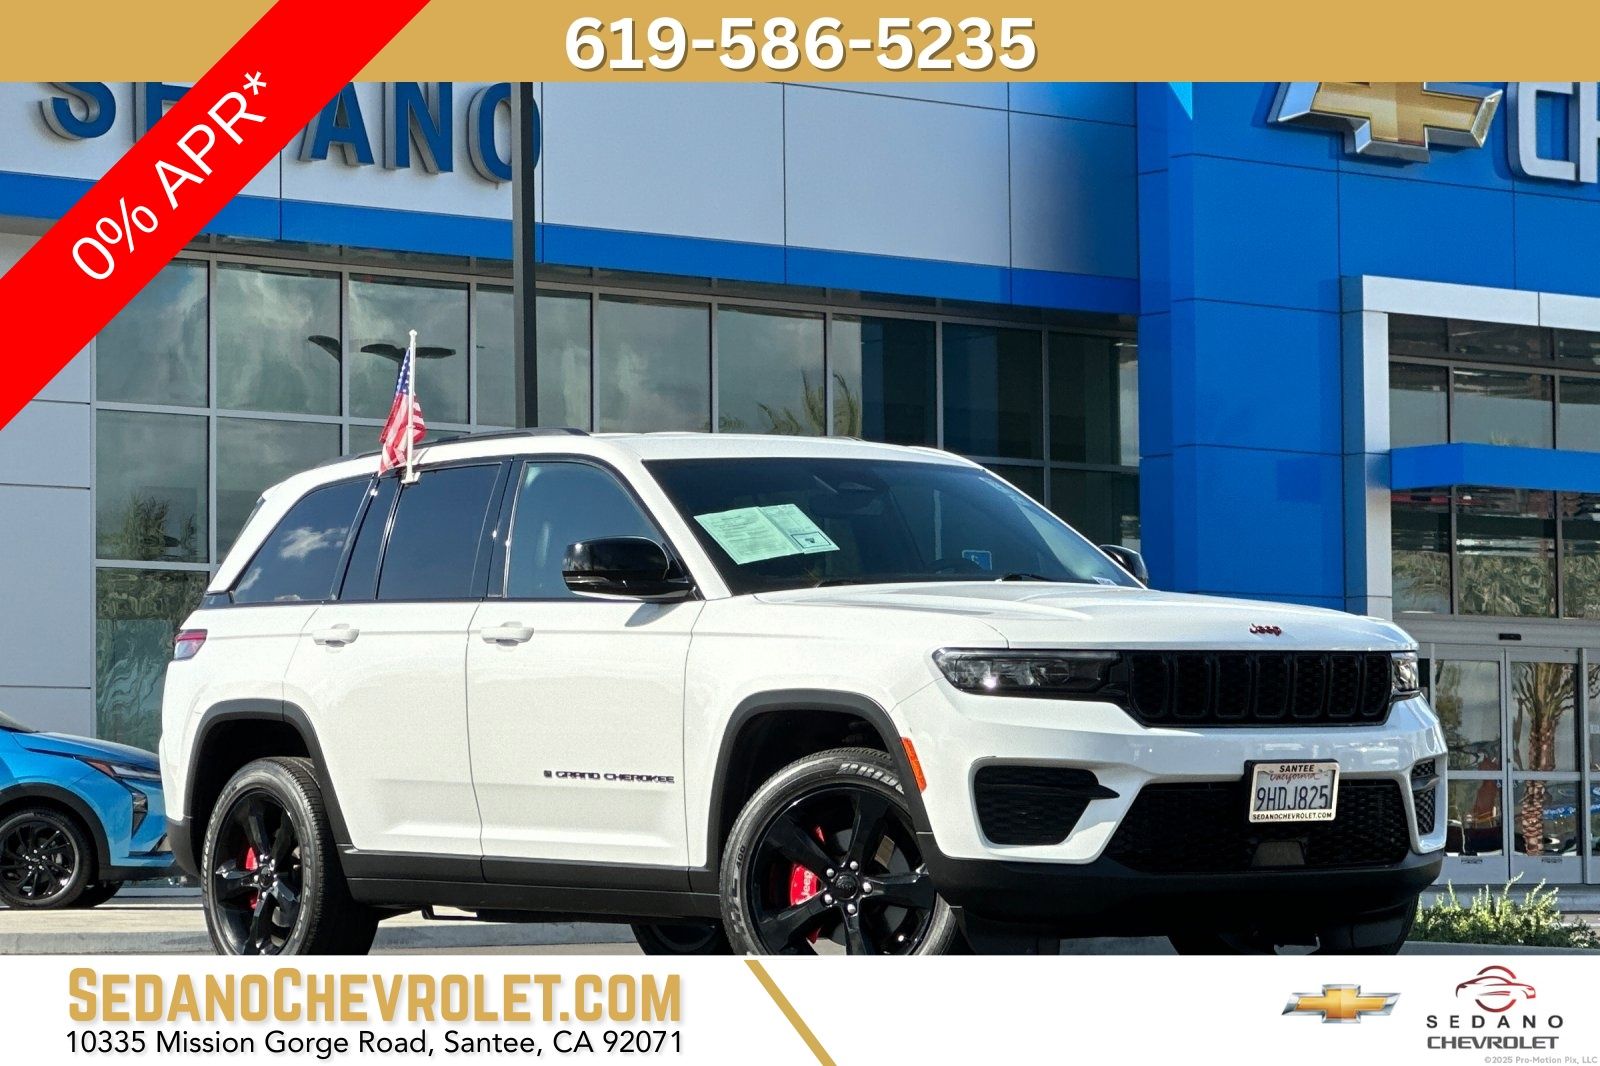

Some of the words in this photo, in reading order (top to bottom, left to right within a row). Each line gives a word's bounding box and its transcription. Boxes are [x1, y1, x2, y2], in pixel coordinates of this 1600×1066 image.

[1279, 764, 1316, 773] SANTEE
[555, 770, 601, 780] GRAND
[603, 773, 675, 784] CHEROKEE
[1255, 785, 1329, 811] 9HDJ825
[1252, 812, 1333, 821] SEDANOCHEVROLET.COM
